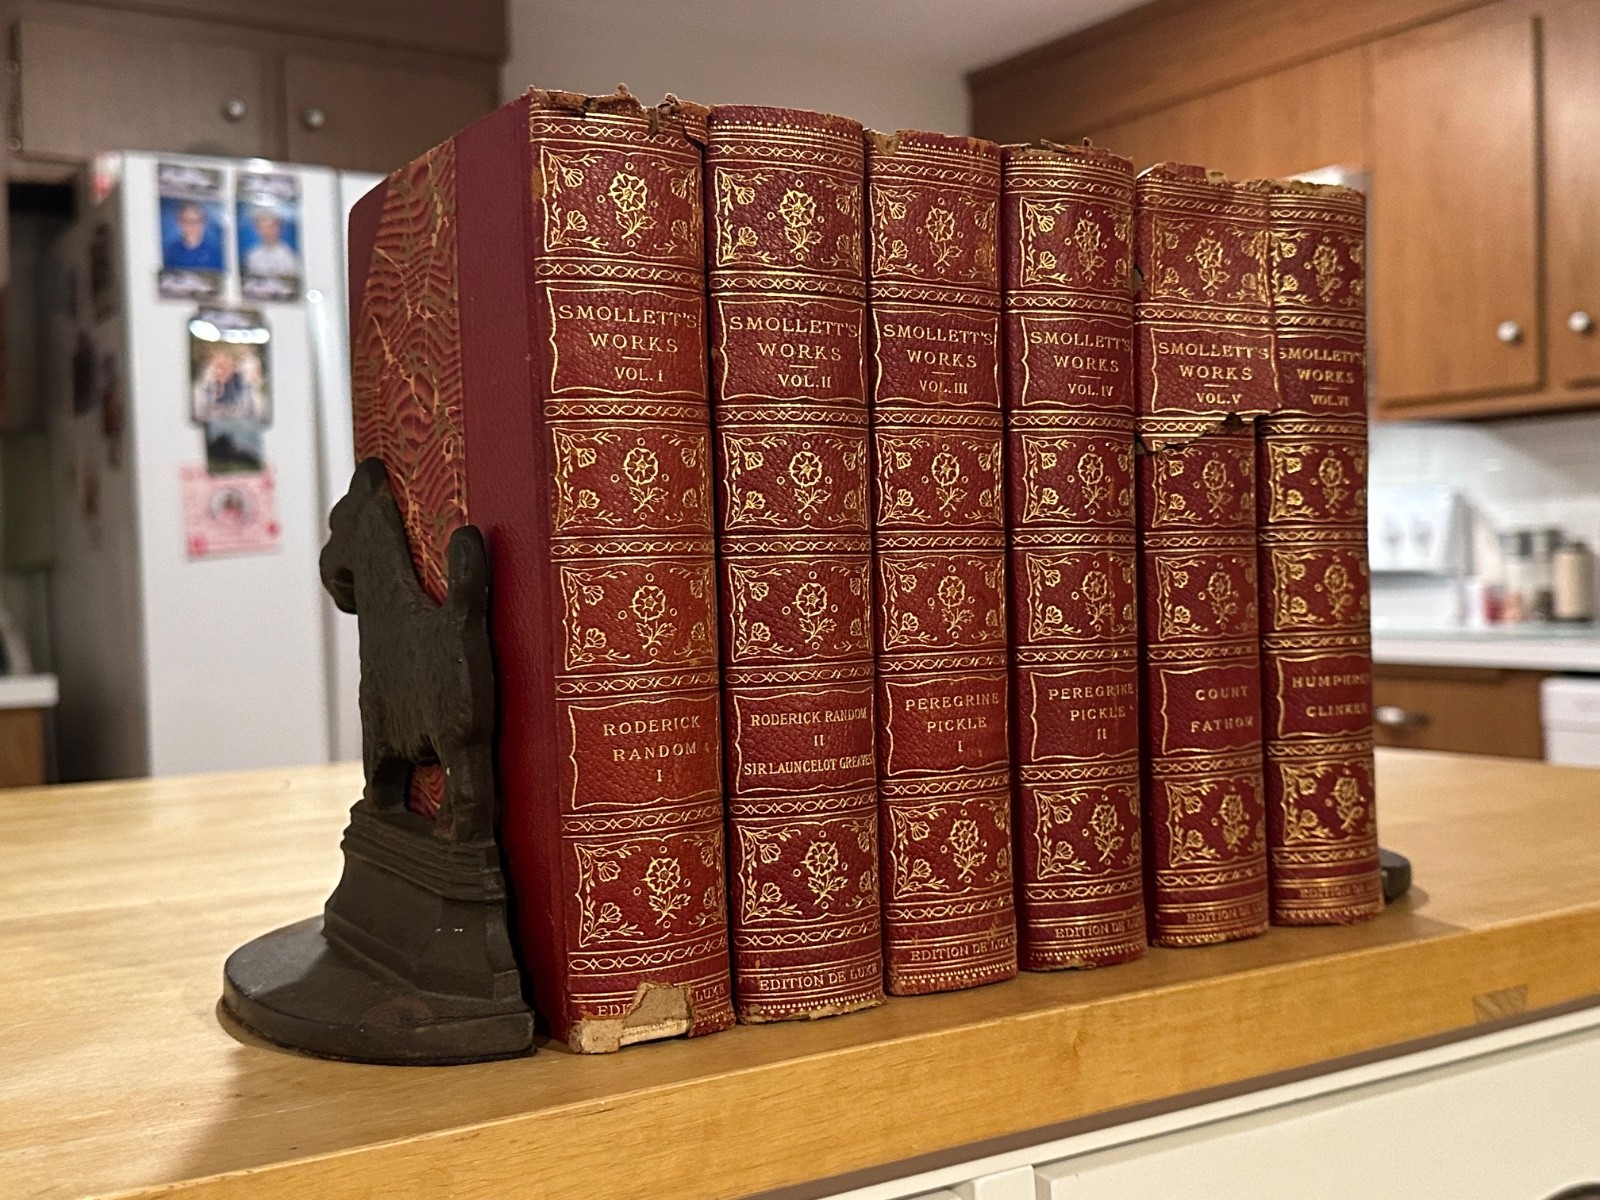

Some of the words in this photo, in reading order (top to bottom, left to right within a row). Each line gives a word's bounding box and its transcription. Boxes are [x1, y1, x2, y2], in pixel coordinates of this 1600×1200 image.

[558, 305, 698, 328] SMOLLETT'S
[729, 316, 859, 337] SMOLLETT'S
[883, 324, 993, 345] SMOLLETT'S
[589, 332, 678, 353] WORKS
[1030, 331, 1131, 351] SMOLLETT'S
[757, 342, 842, 361] WORKS
[906, 349, 977, 368] WORKS
[1053, 355, 1119, 373] WORKS
[1178, 364, 1253, 380] WORKS
[1296, 368, 1354, 384] WORKS
[1048, 683, 1134, 700] PEREGRINE
[1195, 685, 1248, 701] COUNT
[905, 692, 999, 711] PEREGRINE
[750, 711, 821, 727] RODERICK
[825, 706, 868, 722] RANDOM
[1070, 707, 1126, 721] PICKLE
[603, 715, 701, 737] RODERICK
[927, 716, 987, 733] PICKLE
[1190, 715, 1254, 733] FATHOM
[813, 734, 825, 747] II
[1096, 728, 1107, 740] II
[613, 743, 697, 762] RANDOM
[656, 769, 663, 782] I
[744, 762, 767, 776] SIR
[768, 758, 837, 775] LAUNCELOT
[1300, 883, 1351, 899] EDITION
[1186, 906, 1238, 923] EDITION
[1055, 923, 1109, 938] EDITION
[911, 945, 969, 961] EDITION
[972, 941, 988, 954] DE
[759, 975, 824, 991] EDITION
[828, 970, 847, 984] DE
[850, 962, 877, 980] LUXE
[695, 983, 725, 1002] LUXE
